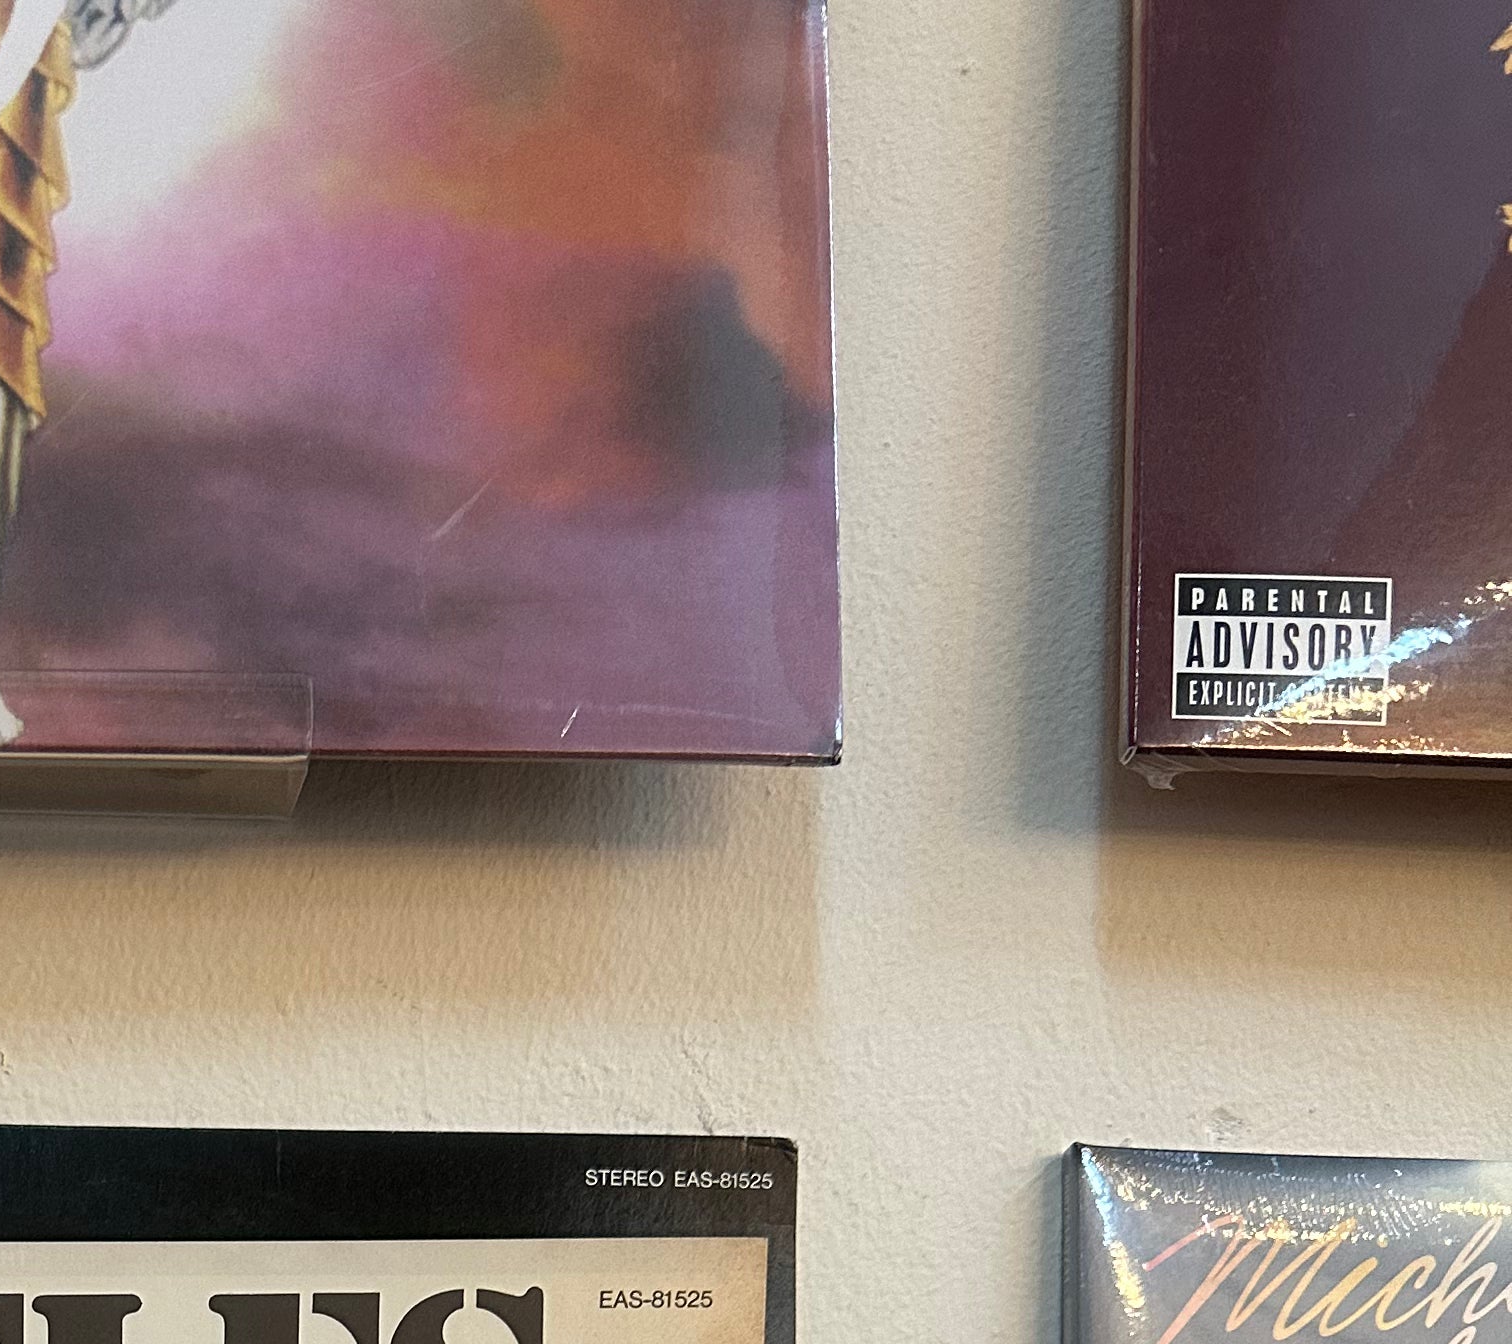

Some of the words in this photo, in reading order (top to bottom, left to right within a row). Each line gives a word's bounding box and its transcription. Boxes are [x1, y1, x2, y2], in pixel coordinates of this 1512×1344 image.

[1190, 587, 1375, 615] PARENTAL
[1185, 620, 1379, 671] ADVISORY
[1187, 679, 1278, 707] EXPLICIT
[585, 1168, 665, 1188] STEREO
[674, 1170, 774, 1190] EAS-81525
[599, 1289, 714, 1309] EAS-81525
